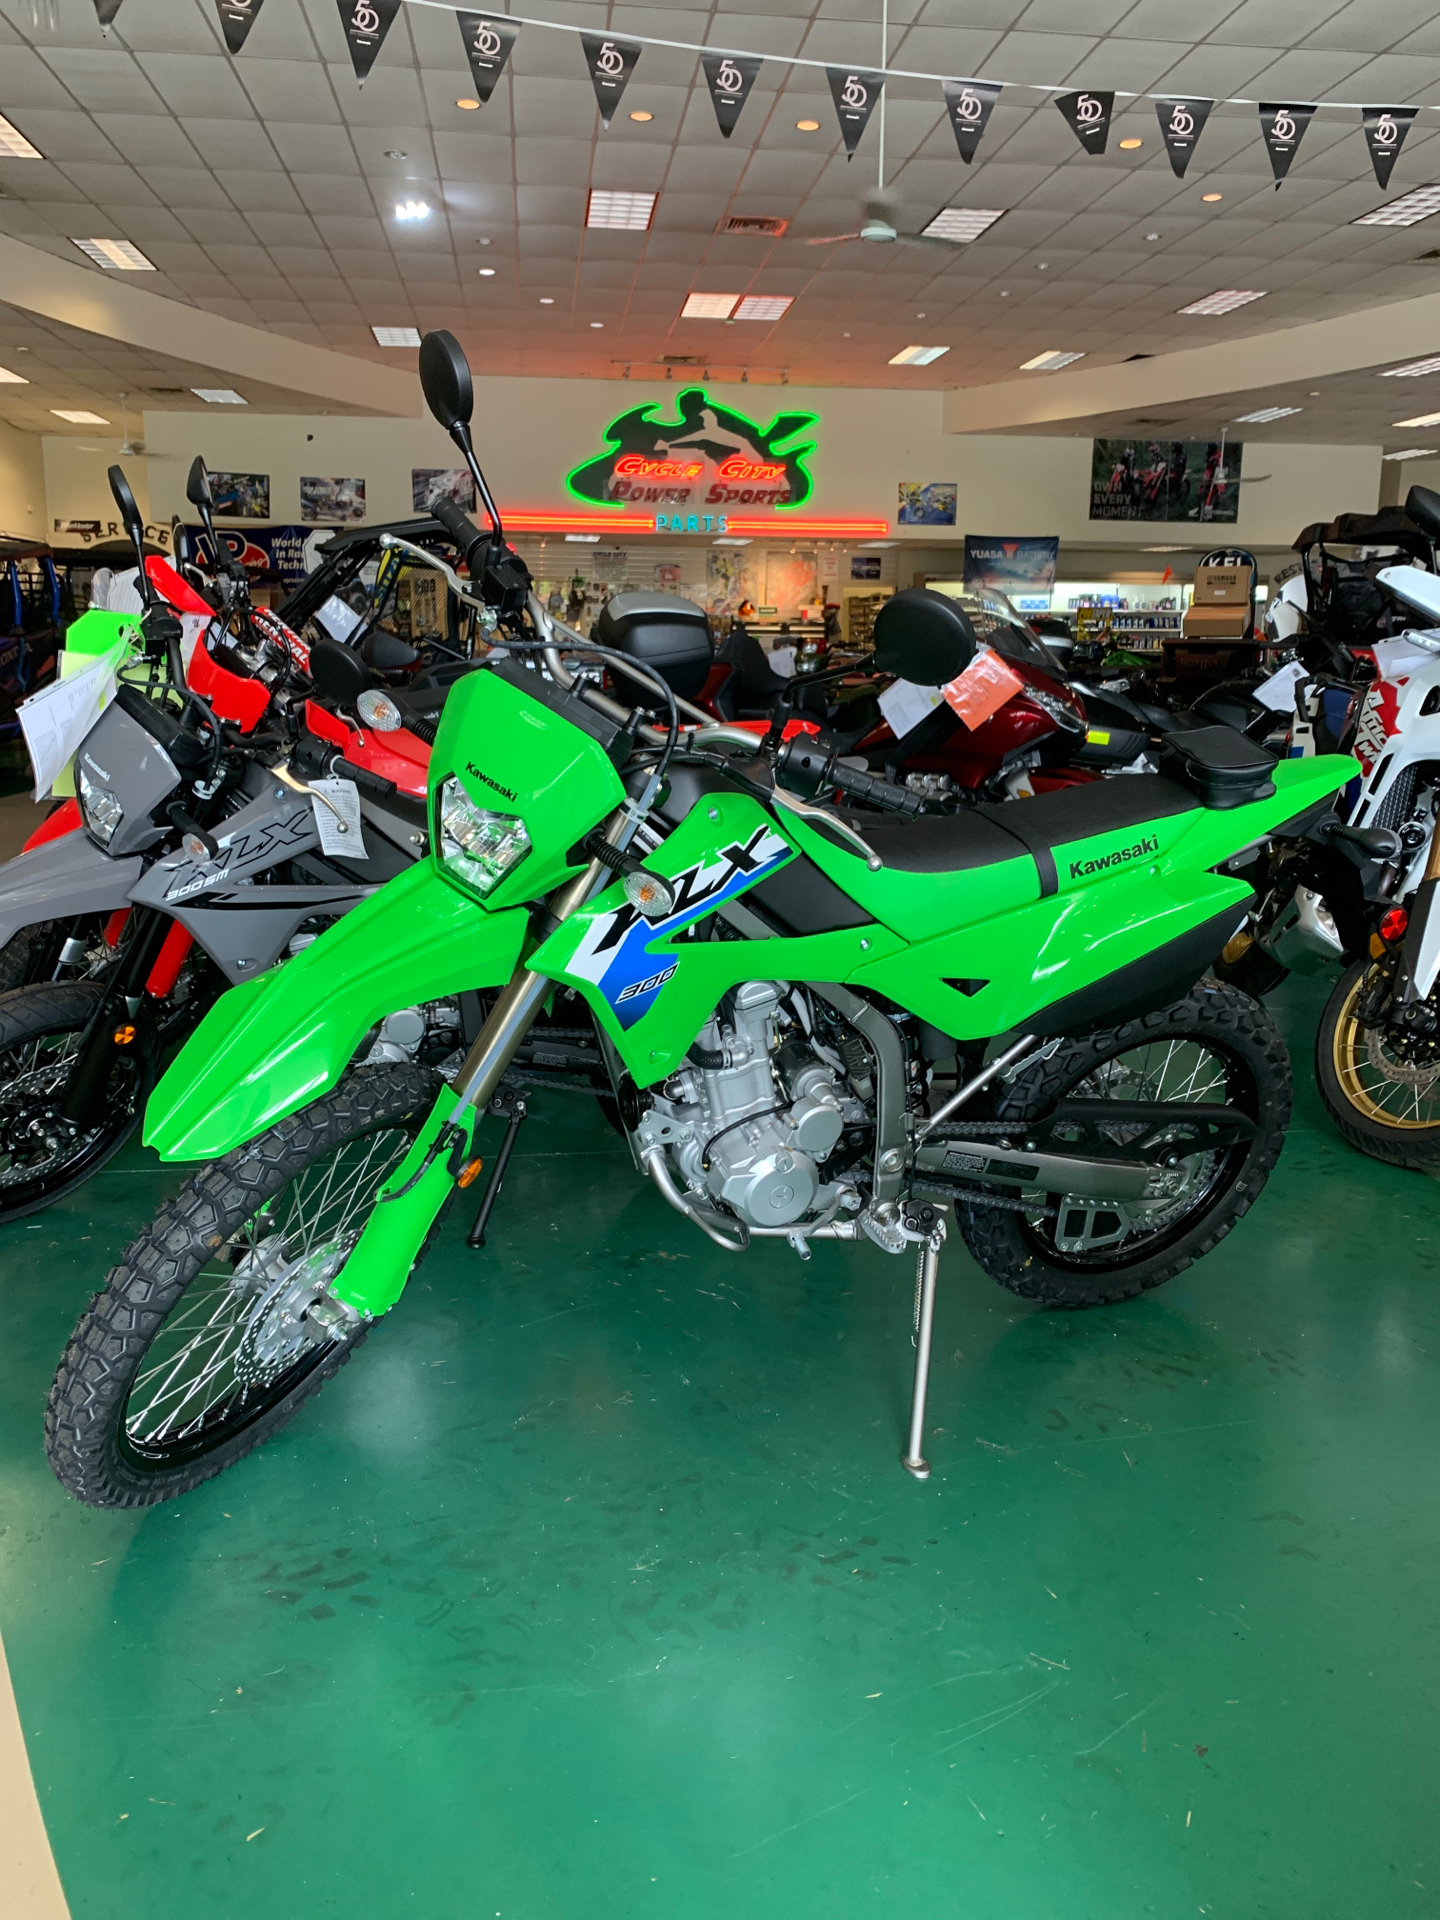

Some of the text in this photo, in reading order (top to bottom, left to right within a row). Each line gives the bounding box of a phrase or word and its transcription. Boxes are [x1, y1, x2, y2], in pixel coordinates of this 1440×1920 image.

[351, 0, 379, 32] 50
[473, 21, 501, 55] 50
[597, 42, 624, 74] 50
[716, 59, 743, 92] 50
[841, 75, 867, 108] 50
[956, 88, 982, 120] 50
[1076, 94, 1102, 122] 50
[1169, 105, 1194, 135] 50
[1271, 109, 1296, 140] 50
[1373, 114, 1398, 144] 50
[1093, 481, 1122, 493] OWN
[1093, 493, 1132, 504] EVERY
[655, 514, 729, 533] PARTS
[1091, 506, 1145, 518] MOMENT
[271, 538, 302, 548] World
[276, 549, 286, 559] in
[970, 549, 1055, 559] YUASA BATTERY
[84, 752, 111, 782] Kawasaki
[465, 761, 518, 802] Kawasaki
[1069, 833, 1159, 880] Kawasaki
[615, 961, 680, 1005] 300
